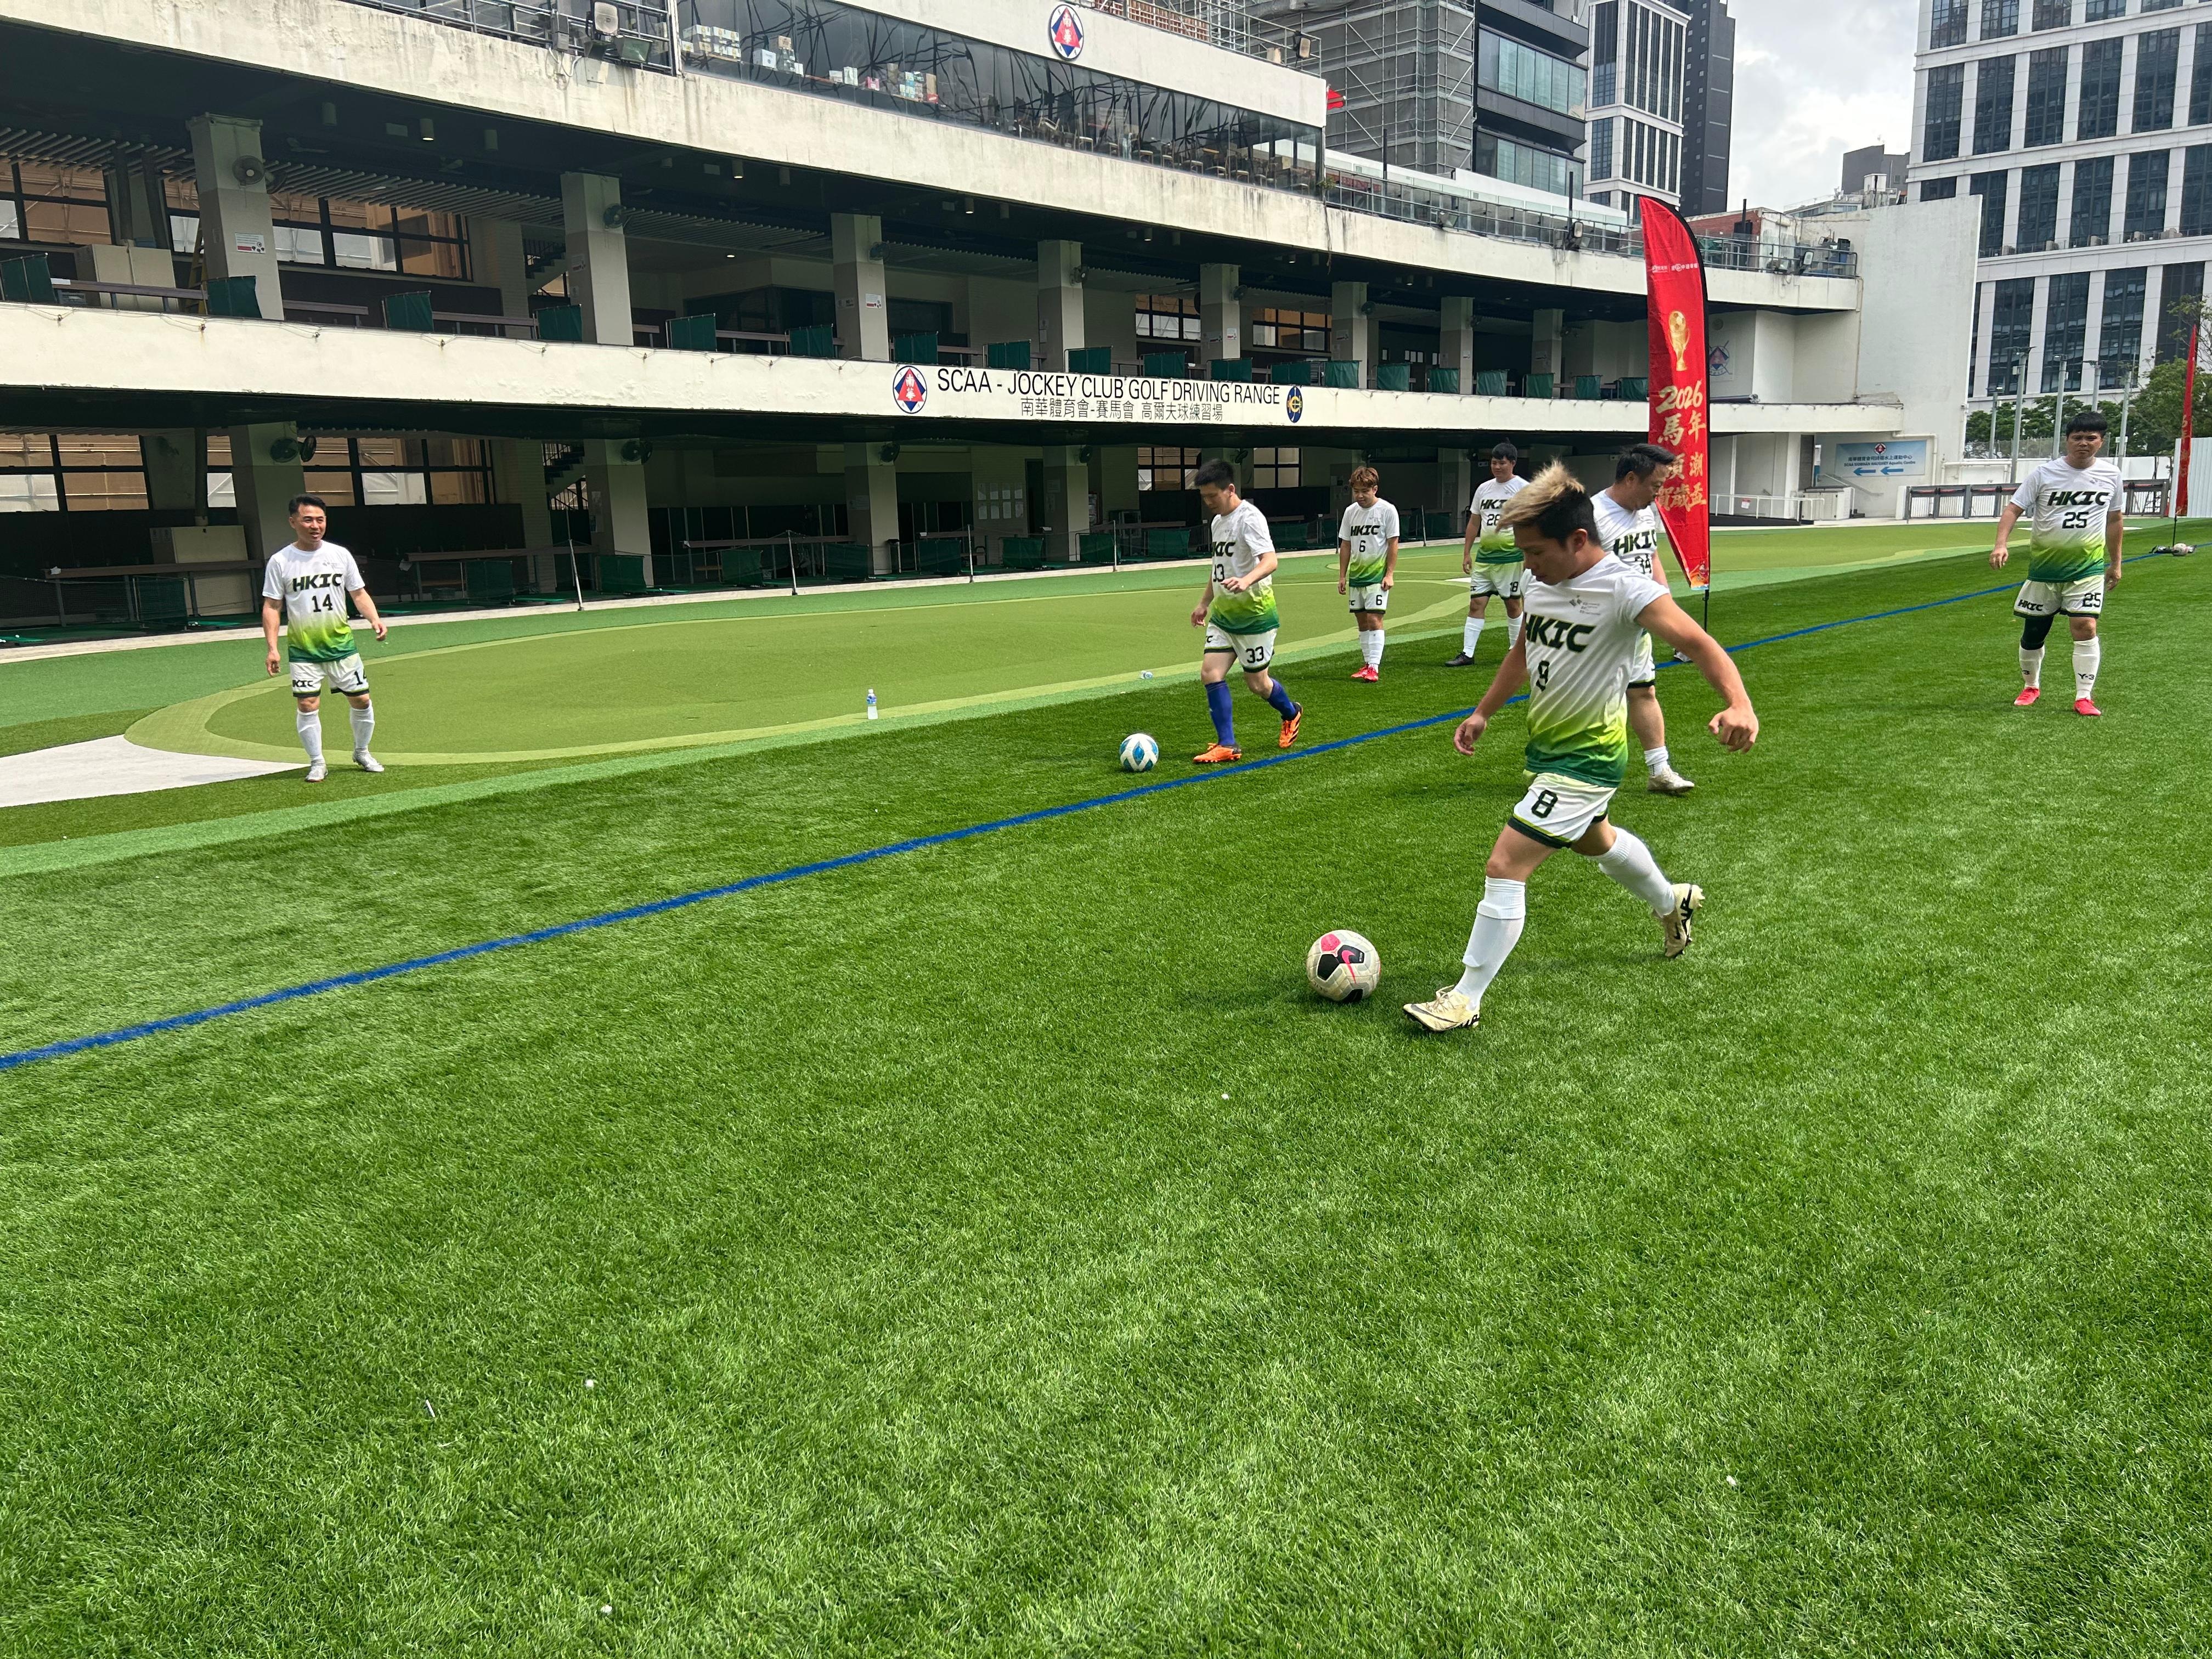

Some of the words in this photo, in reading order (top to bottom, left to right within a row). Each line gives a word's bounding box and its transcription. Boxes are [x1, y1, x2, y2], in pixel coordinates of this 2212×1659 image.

[906, 373, 916, 401] 南華
[938, 368, 992, 393] SCAA
[1007, 373, 1077, 397] JOCKEY
[1082, 377, 1124, 398] CLUB
[1128, 379, 1168, 400] GOLF
[1173, 382, 1229, 402] DRIVING
[1234, 385, 1280, 404] RANGE
[1655, 379, 1703, 414] 2026
[1142, 401, 1223, 421] 高爾夫球練習場
[1657, 410, 1706, 446] 馬年
[1480, 499, 1504, 510] HKI
[2047, 491, 2110, 506] HKIC
[2062, 512, 2089, 529] 25
[1350, 525, 1381, 537] HKIC
[1211, 541, 1236, 557] KIC
[1359, 540, 1366, 552] 6
[292, 573, 343, 592] HKIC
[312, 594, 333, 612] 14
[1376, 595, 1383, 606] 6
[2018, 599, 2044, 612] HKIC
[2082, 592, 2101, 607] 25
[1525, 612, 1597, 653] HKIC
[1245, 646, 1264, 664] 33
[292, 679, 313, 688] KIC
[1531, 789, 1558, 818] 8
